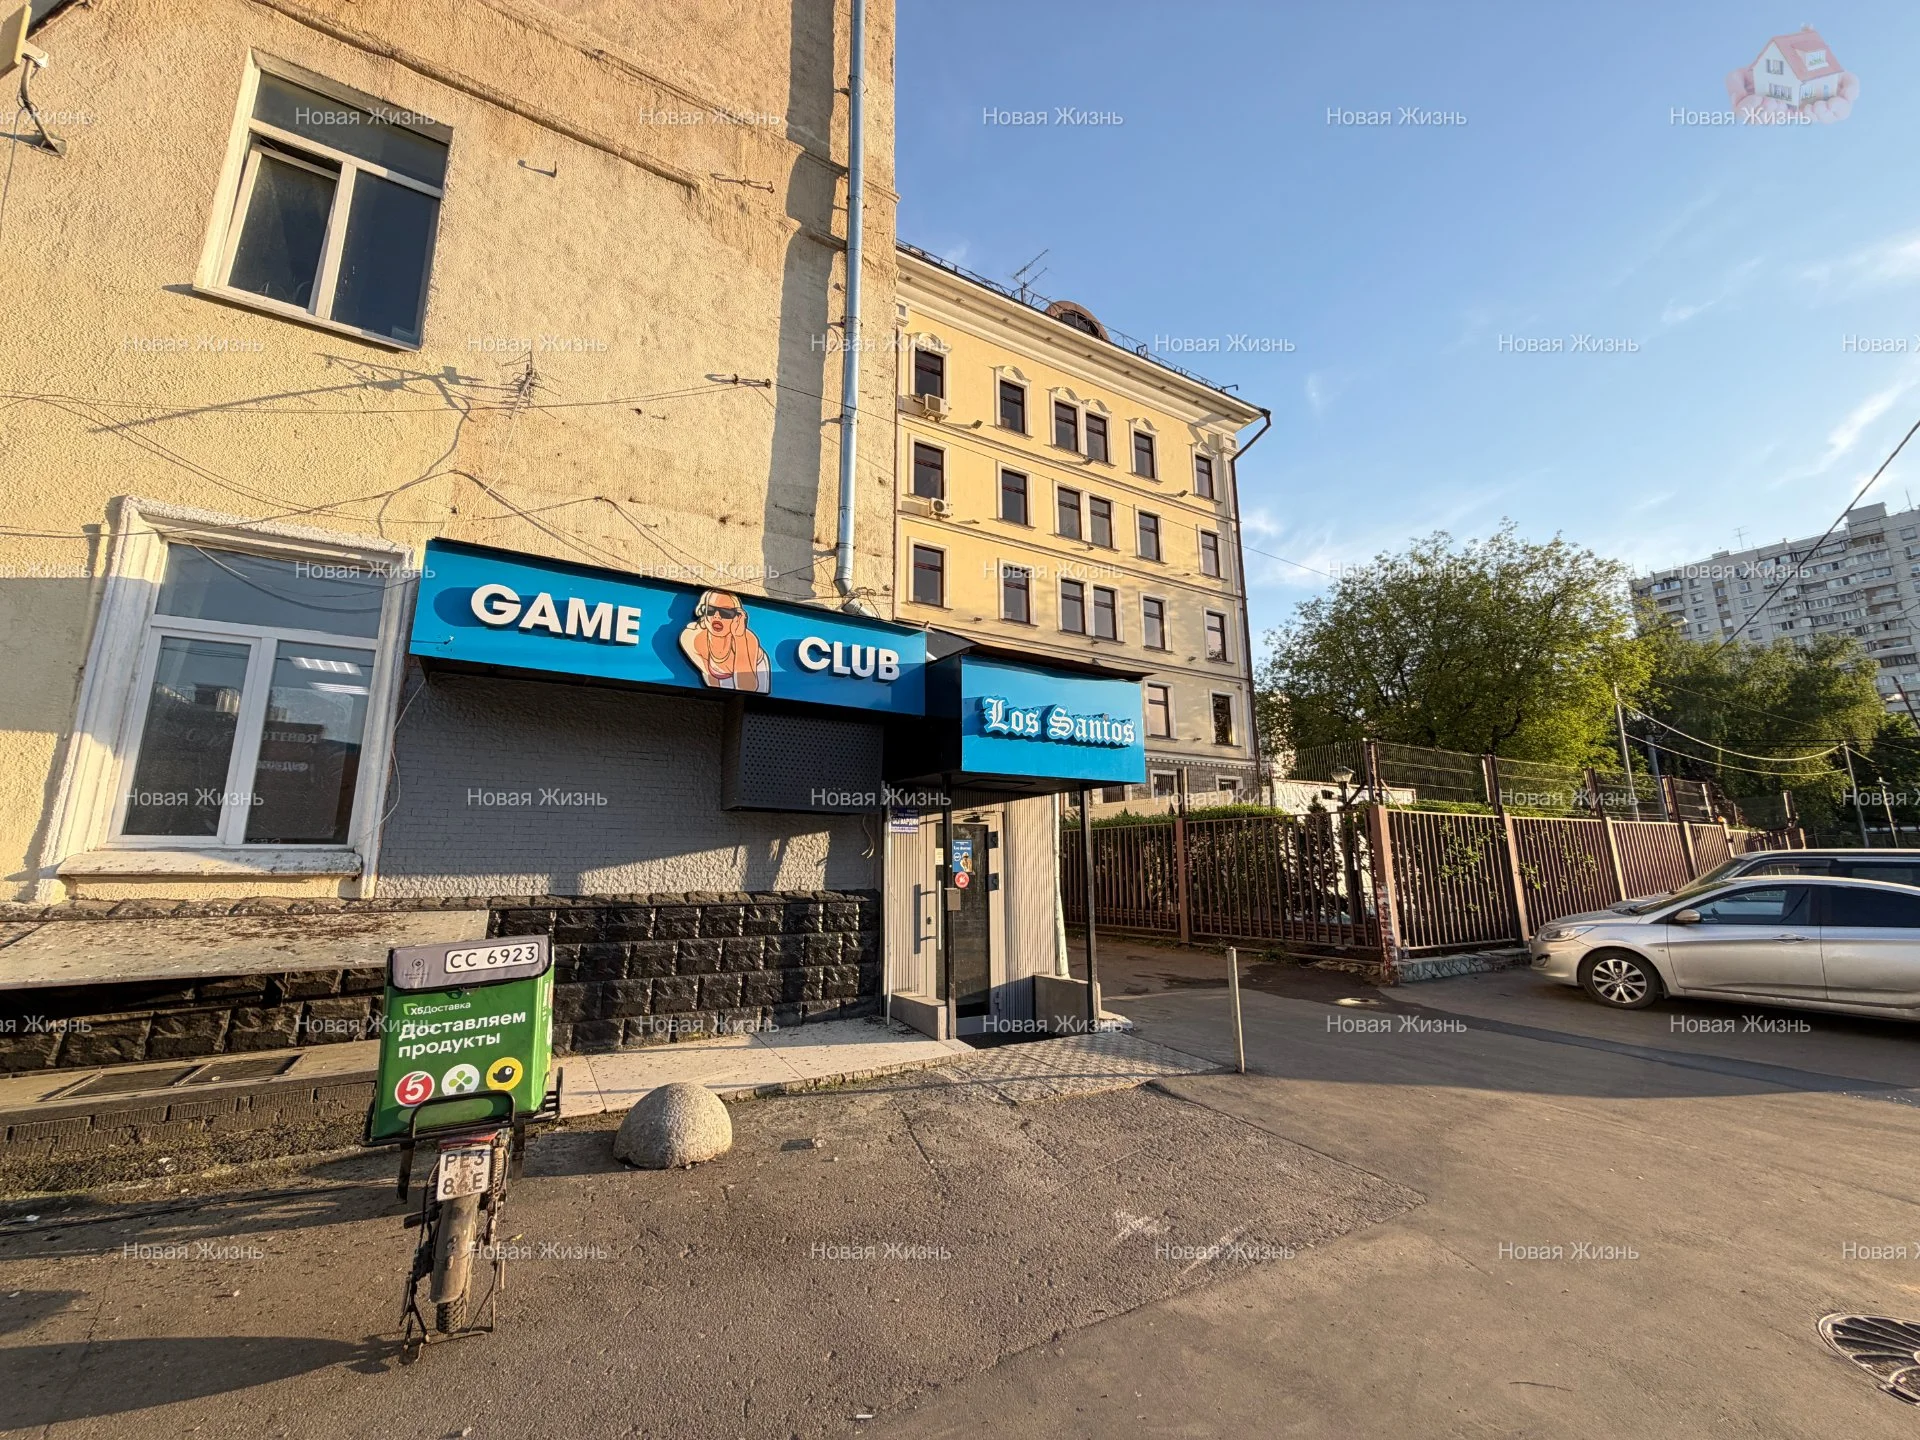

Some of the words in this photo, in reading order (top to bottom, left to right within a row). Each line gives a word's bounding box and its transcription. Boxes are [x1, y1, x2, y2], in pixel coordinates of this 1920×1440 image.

[471, 584, 641, 644] GAME
[798, 636, 900, 680] CLUB
[984, 696, 1040, 735] Los
[1049, 706, 1135, 743] Santos
[487, 946, 535, 965] 6923
[398, 1011, 526, 1041] Доставляем
[398, 1032, 500, 1059] продукты
